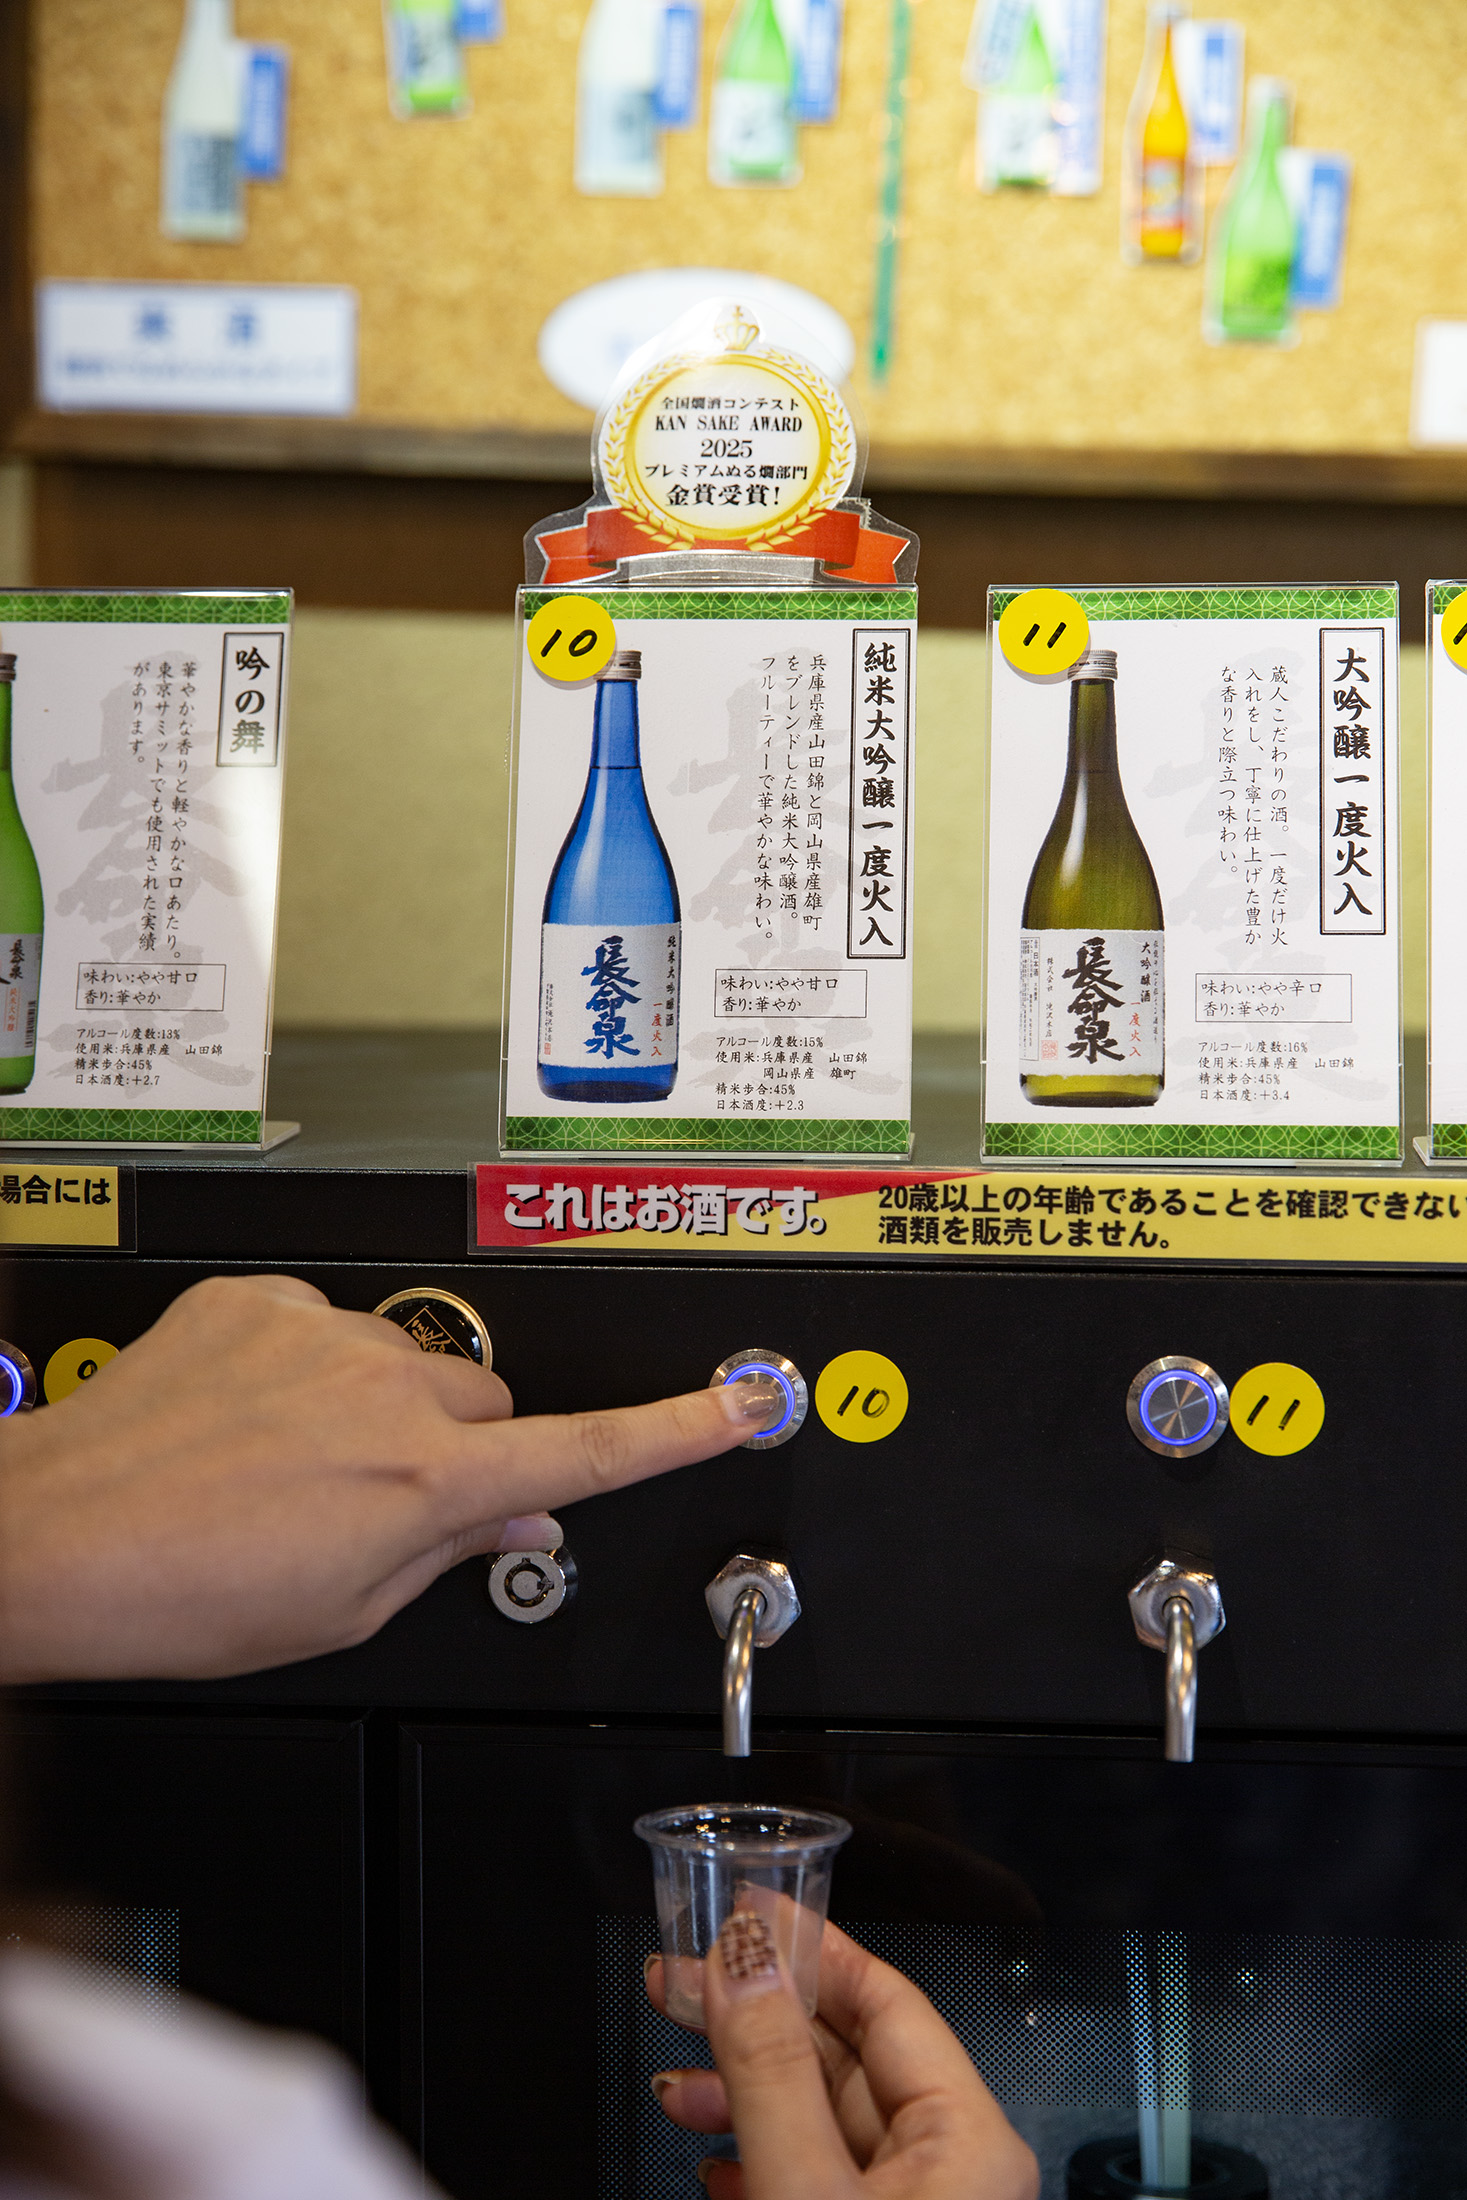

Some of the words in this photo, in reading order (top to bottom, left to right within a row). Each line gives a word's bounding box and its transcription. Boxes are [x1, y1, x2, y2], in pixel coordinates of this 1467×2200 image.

[655, 415, 687, 431] KAN
[697, 416, 740, 431] SAKE
[750, 416, 802, 432] AWARD
[701, 439, 752, 458] 2025
[540, 629, 597, 657] 10
[1023, 622, 1067, 649] 11
[128, 661, 150, 764] があります。
[229, 646, 270, 754] 吟の舞
[1217, 665, 1238, 874] な香りと際立つ味わい。
[1332, 647, 1373, 916] 大吟醸一度火入
[754, 656, 776, 939] フルーティーで華やかな味わい。
[779, 655, 802, 920] をブレンドした純米大吟醸酒。
[803, 654, 827, 931] 兵庫県産山田錦と岡山県産雄町
[860, 642, 898, 947] 純米大吟醸一度火入
[138, 660, 174, 952] 東京サミットでも使用された実績
[165, 661, 198, 959] 華やかな香りと軽やかな口あたり。
[1243, 667, 1264, 946] 入れをし、丁寧に仕上げた豊か
[83, 968, 198, 985] 味わい:やや甘口
[721, 975, 838, 992] 味わい:やや甘口
[1201, 979, 1322, 997] 味わい:やや辛口
[84, 989, 161, 1005] 香り:華やか
[722, 997, 802, 1012] 香り:華やか
[1203, 1001, 1285, 1017] 香り:華やか
[651, 1002, 663, 1057] 一度火入
[716, 1035, 824, 1047] アルコール度数:15%
[1129, 1001, 1142, 1057] 一度火入
[186, 1044, 223, 1056] 山田錦
[715, 1051, 814, 1064] 使用米:兵庫県産
[829, 1052, 868, 1064] 山田錦
[1198, 1040, 1308, 1053] アルコール度数:16%
[763, 1067, 815, 1080] 岡山県産
[829, 1067, 856, 1080] 雄町
[1199, 1057, 1298, 1070] 使用米:兵庫県産
[1314, 1057, 1354, 1069] 山田錦
[715, 1083, 796, 1095] 精米歩合:45%
[1199, 1072, 1281, 1085] 精米歩合:45%
[504, 1182, 827, 1236] これはお酒です。
[878, 1216, 1171, 1250] 酒類を販売しません。
[837, 1385, 890, 1418] 10
[1246, 1395, 1300, 1431] 11
